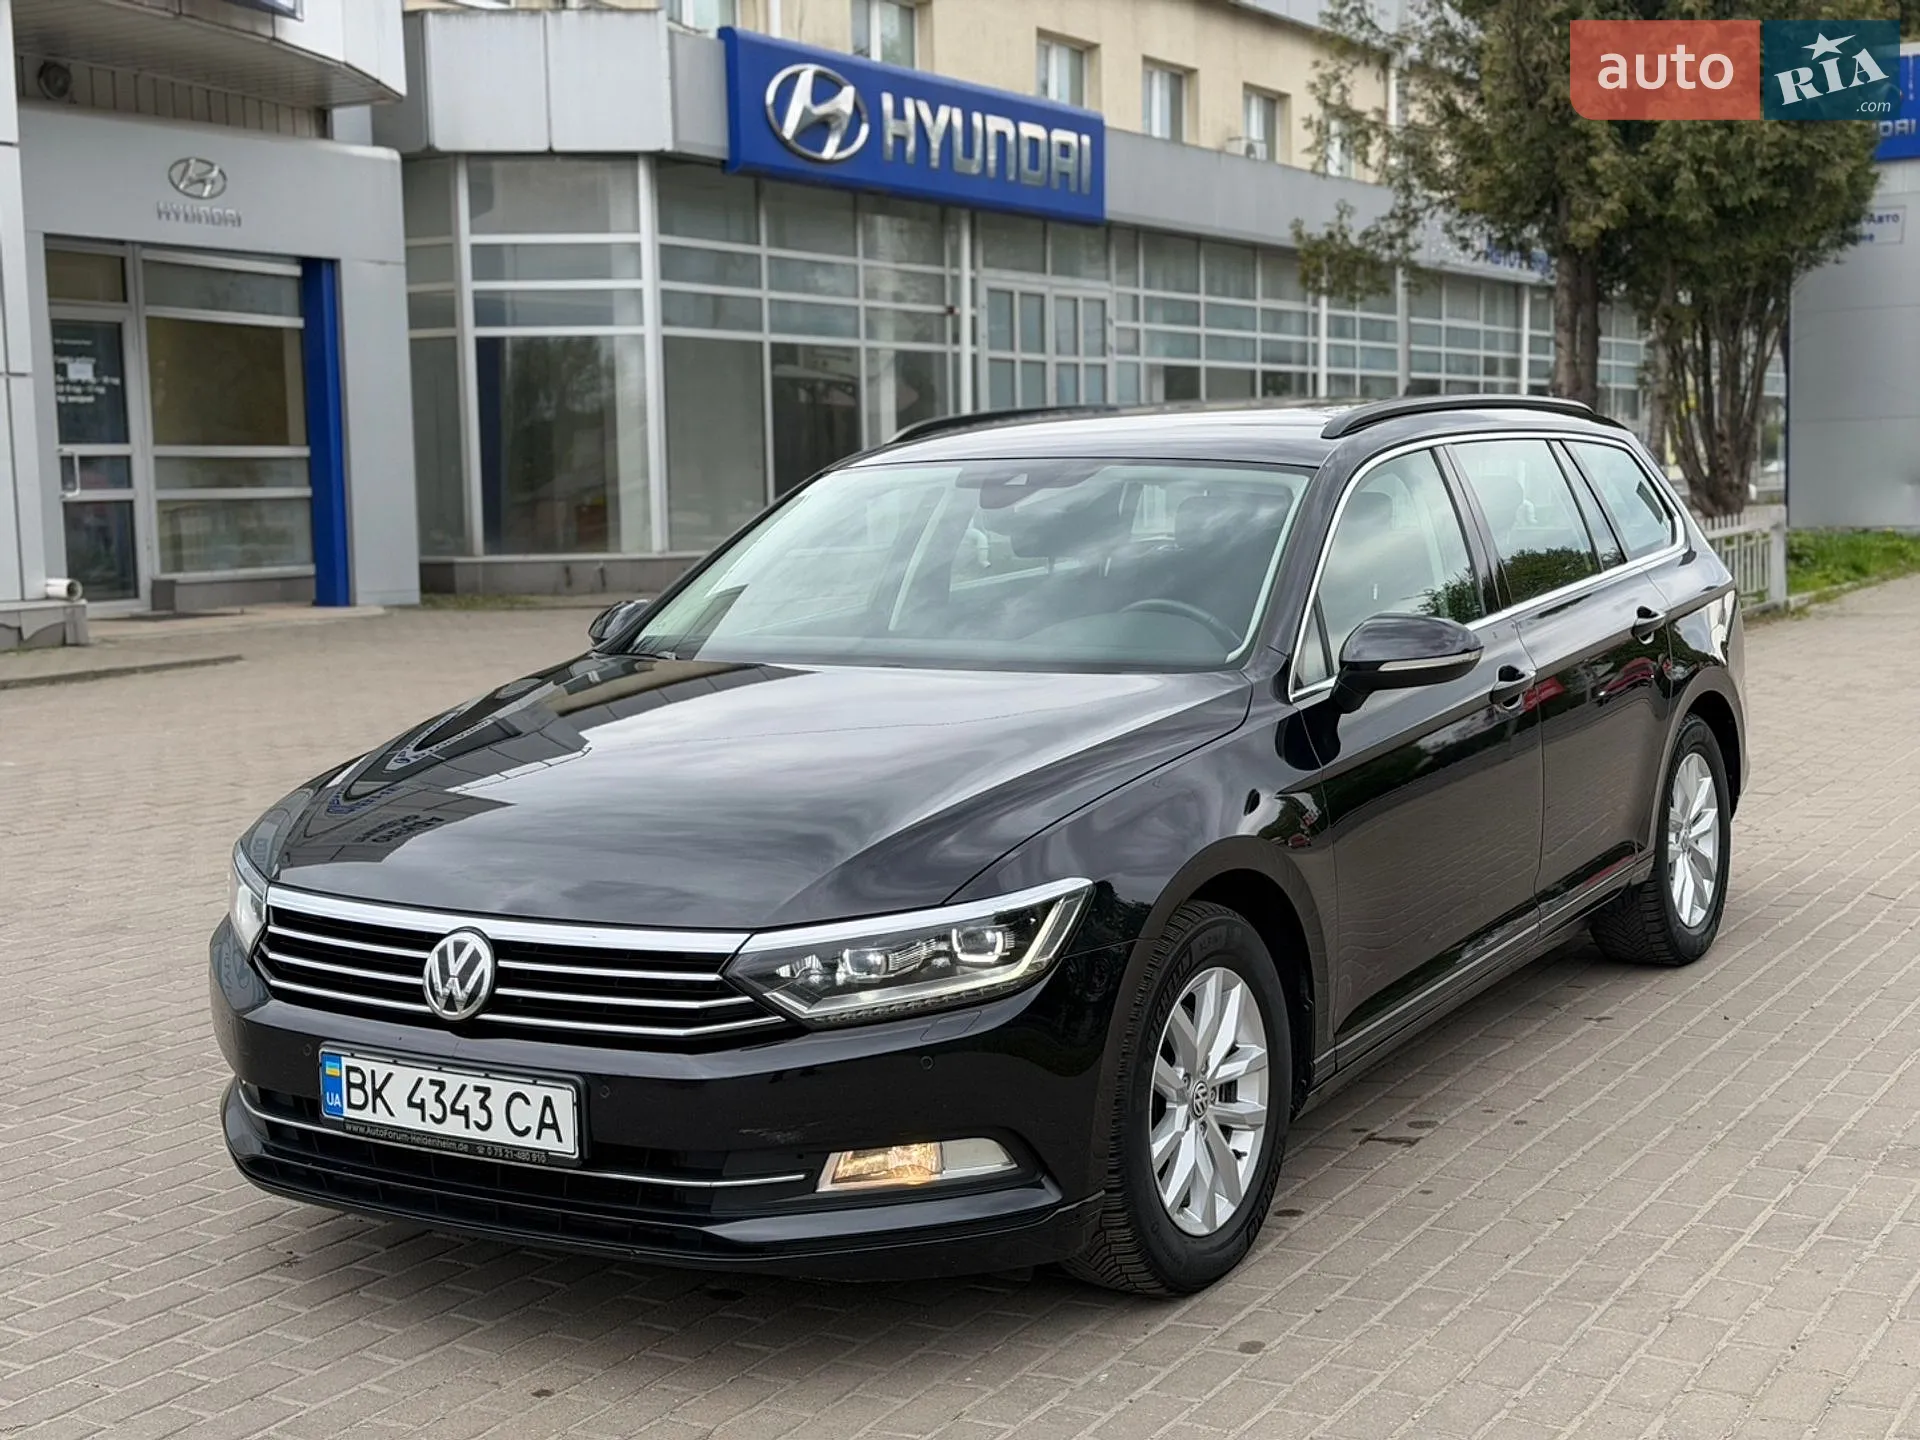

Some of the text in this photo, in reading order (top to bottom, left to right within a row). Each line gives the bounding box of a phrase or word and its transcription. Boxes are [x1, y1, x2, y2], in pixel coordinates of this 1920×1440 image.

[881, 91, 1092, 195] HYUNDAI
[156, 200, 242, 228] HYUNDAI
[326, 1091, 342, 1108] UA
[345, 1065, 563, 1143] BK 4343 CA
